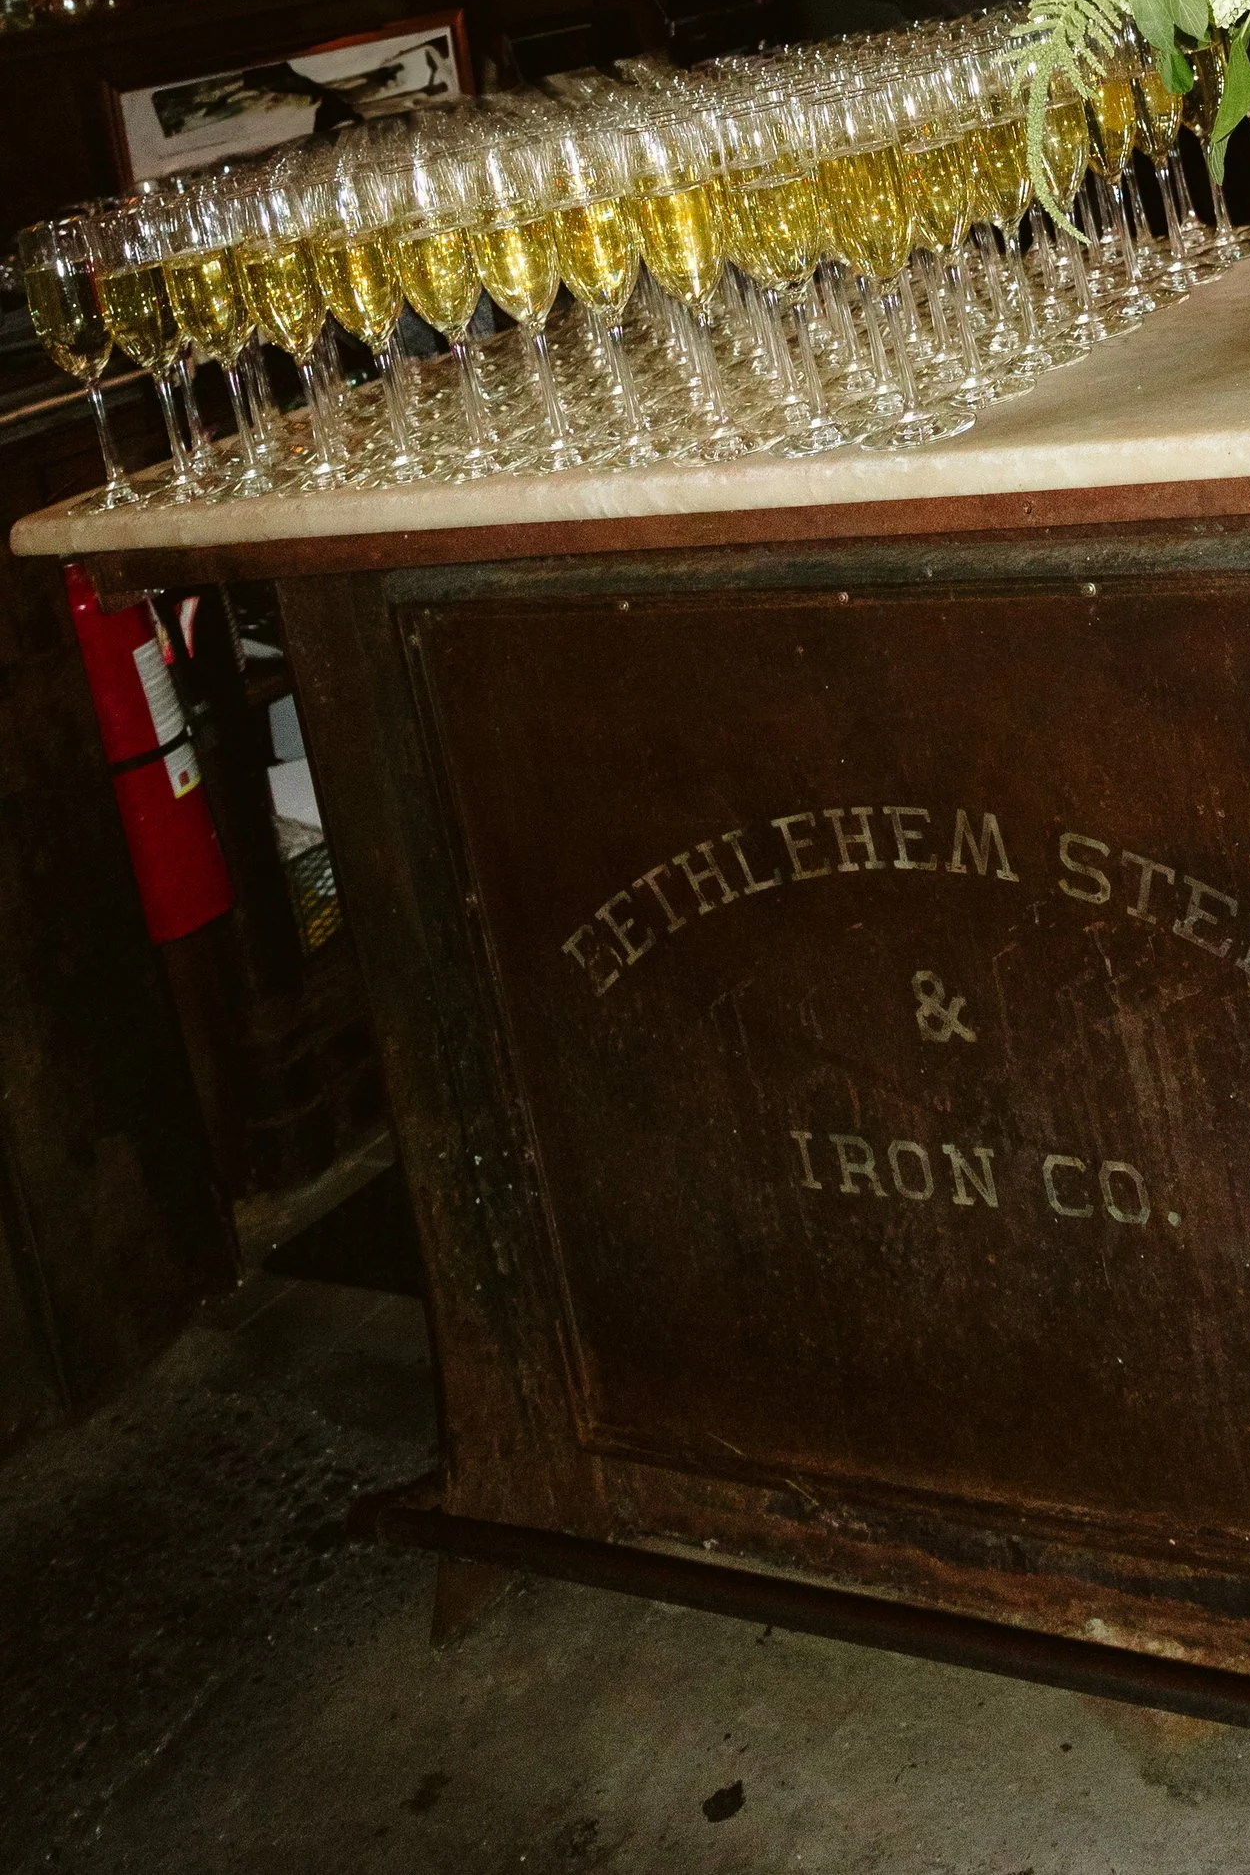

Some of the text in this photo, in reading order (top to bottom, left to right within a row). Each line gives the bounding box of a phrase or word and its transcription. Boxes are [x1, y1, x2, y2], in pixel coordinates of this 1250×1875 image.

[912, 971, 977, 1042] &
[792, 1130, 1182, 1226] IRON CO.
